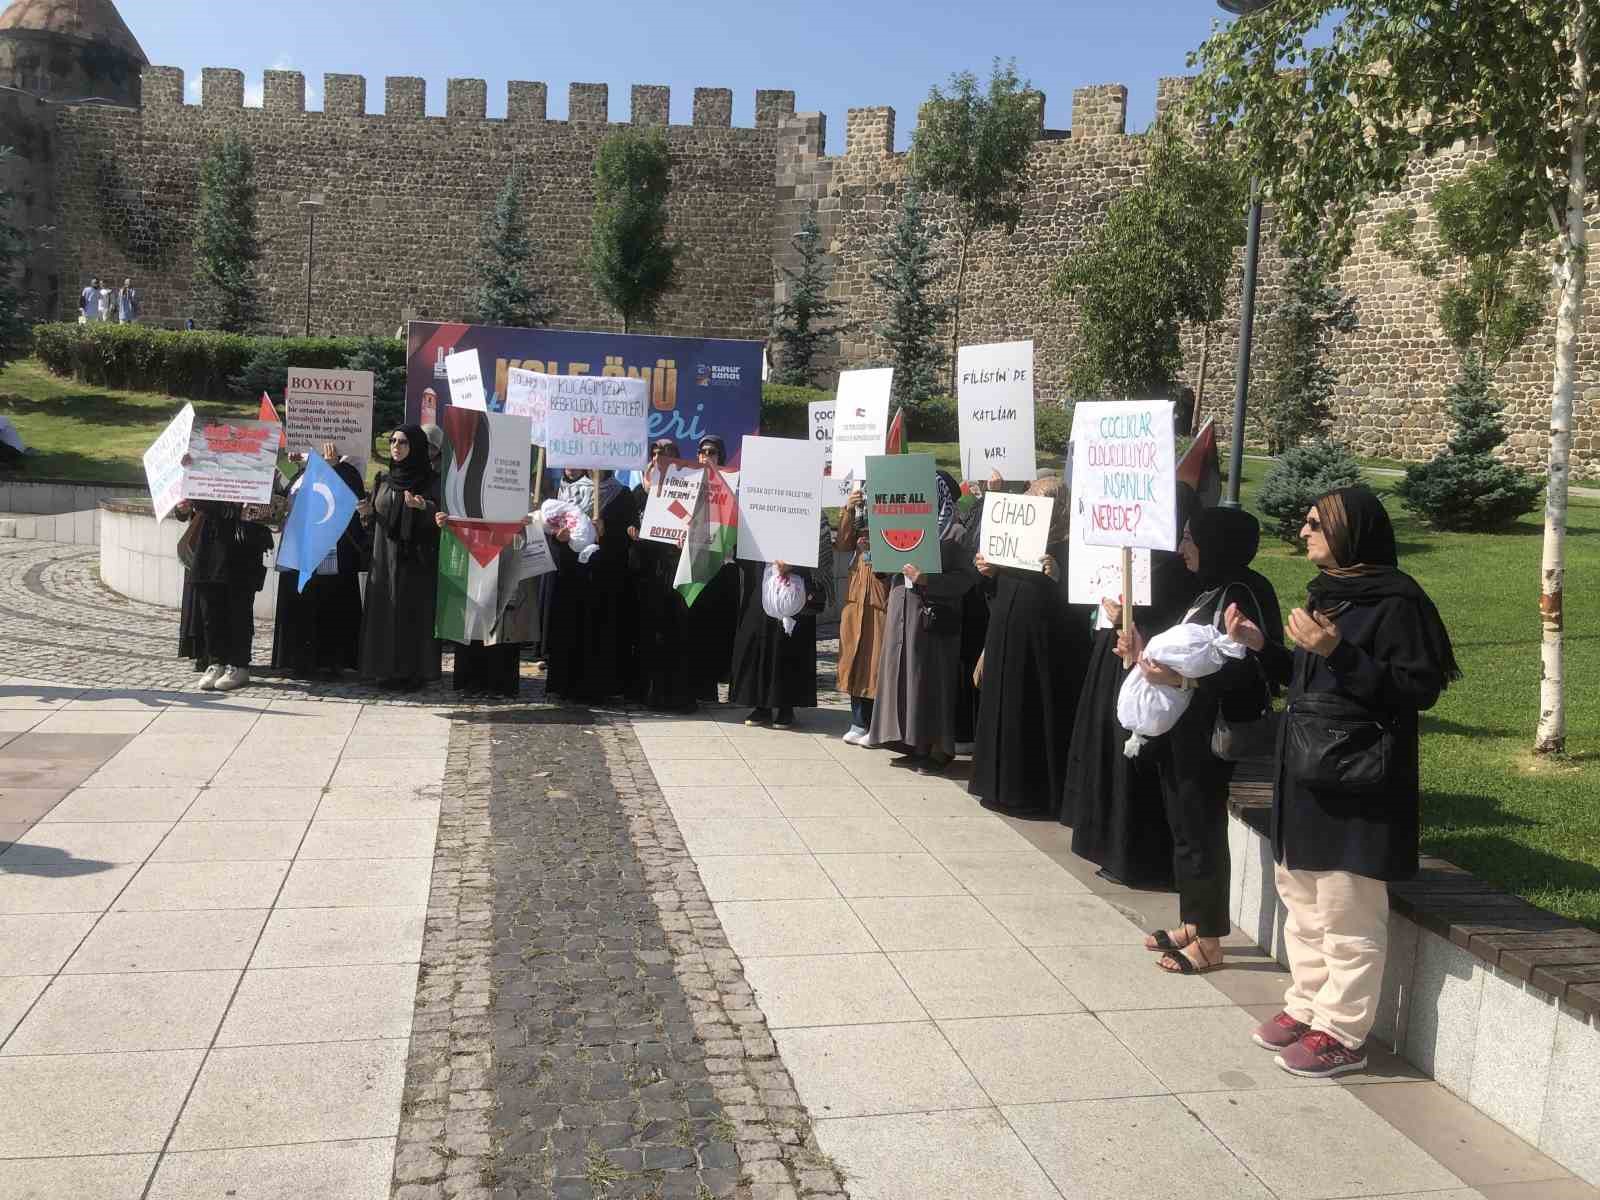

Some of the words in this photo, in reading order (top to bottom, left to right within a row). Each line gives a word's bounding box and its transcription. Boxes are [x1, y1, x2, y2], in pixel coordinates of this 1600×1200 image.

[1013, 369, 1028, 382] DE
[292, 376, 355, 392] BOYKOT
[815, 410, 835, 423] ÇOC
[972, 405, 1017, 422] KATLİAM
[815, 426, 833, 441] ÖL
[984, 446, 1007, 460] VAR!
[670, 477, 689, 488] ÜRÜN
[875, 493, 888, 505] WE
[889, 493, 907, 504] ARE
[908, 493, 926, 504] ALL
[991, 497, 1036, 526] CİHAD
[1091, 503, 1142, 538] NEREDE?
